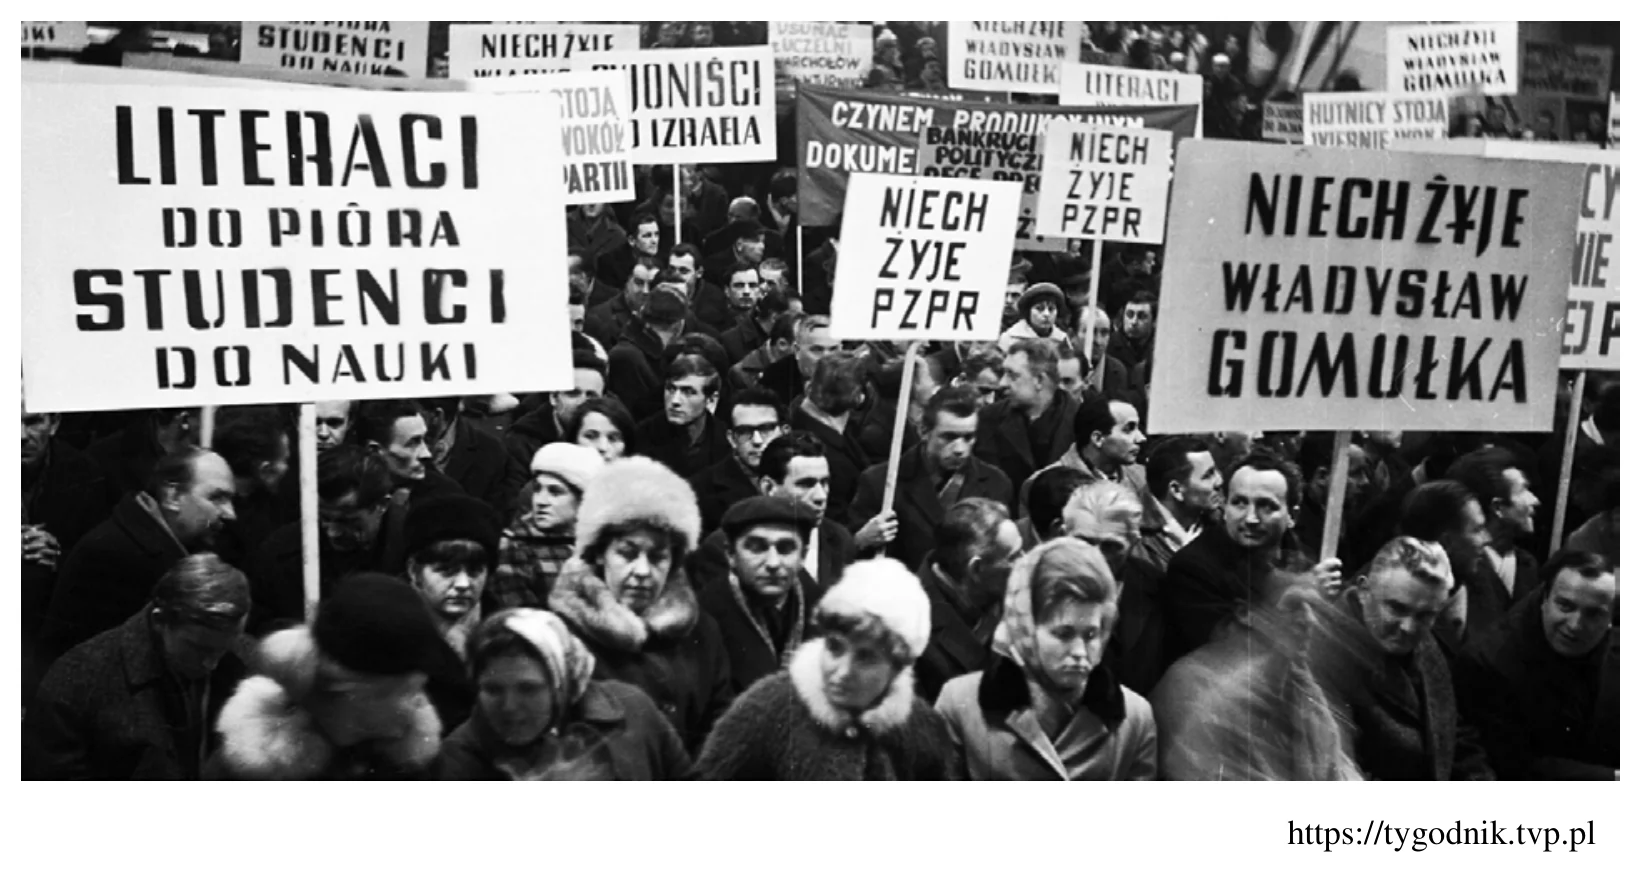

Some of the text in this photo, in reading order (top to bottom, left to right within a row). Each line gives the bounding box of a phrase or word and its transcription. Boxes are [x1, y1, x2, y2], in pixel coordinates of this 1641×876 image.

[257, 24, 406, 62] STUDENCI
[481, 33, 557, 58] NIECH
[965, 38, 1068, 60] WŁADYSŁAW
[280, 54, 314, 70] DO
[964, 57, 1059, 83] GOMUŁK
[591, 57, 761, 113] JONIŚCI
[1085, 70, 1179, 103] LITERACI
[831, 99, 935, 134] CZYNEM
[1309, 100, 1386, 125] HUTNICY
[115, 104, 479, 190] LITERACI
[650, 115, 762, 147] IZRAELA
[926, 126, 1037, 152] BANKRUCI
[1069, 130, 1149, 165] NIECH
[806, 141, 920, 175] DOKUME
[563, 160, 629, 194] ARTII
[1067, 163, 1134, 202] ŻYJE
[161, 202, 462, 248] DO PIÓRA
[879, 184, 989, 232] NIECH
[1061, 203, 1142, 238] PZPR
[1244, 172, 1530, 258] NIECH ŻYJE
[878, 230, 967, 282] ŻYJE
[73, 267, 507, 332] STUDENCI
[871, 287, 980, 331] PZPR
[1221, 260, 1529, 323] WŁADYSŁAW
[155, 342, 478, 390] DO NAUKI
[1206, 328, 1528, 404] GOMUŁKA
